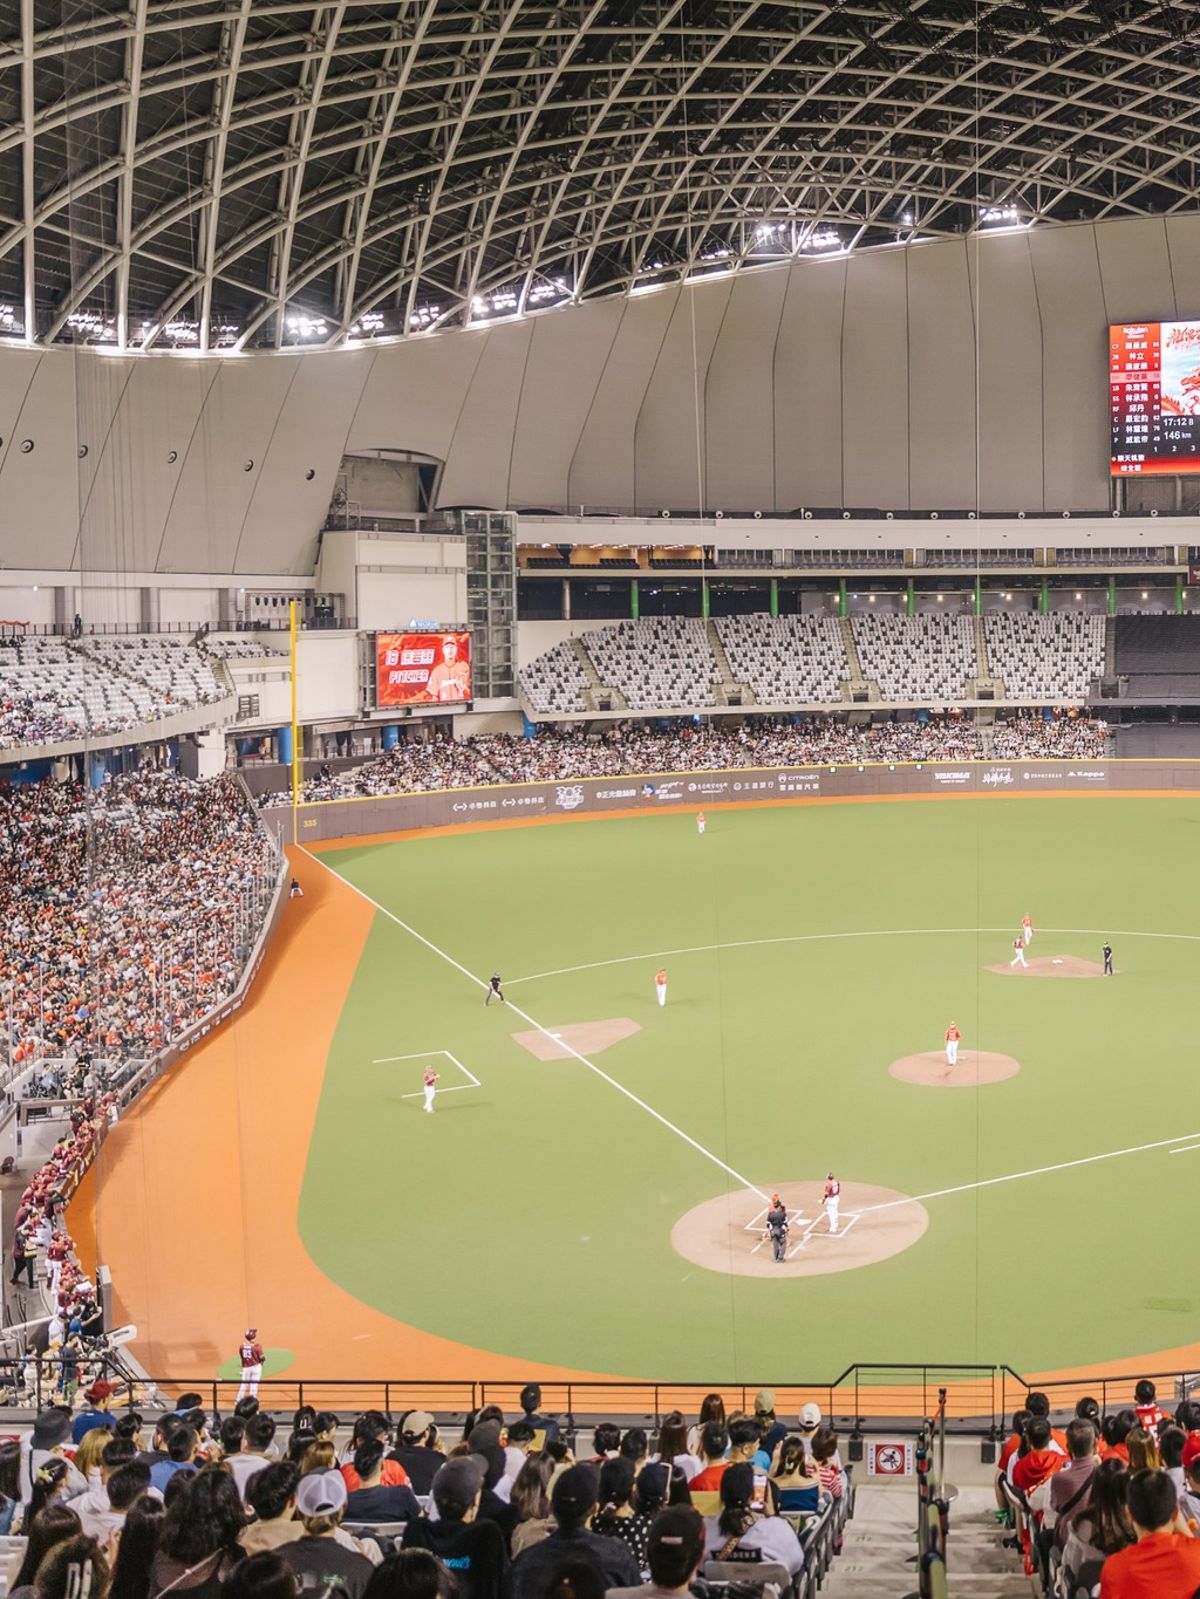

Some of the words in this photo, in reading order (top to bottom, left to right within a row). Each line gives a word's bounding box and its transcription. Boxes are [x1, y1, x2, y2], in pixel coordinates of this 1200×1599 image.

[1164, 418, 1187, 426] 17:12
[385, 650, 399, 666] 18
[388, 669, 430, 684] PITCHER
